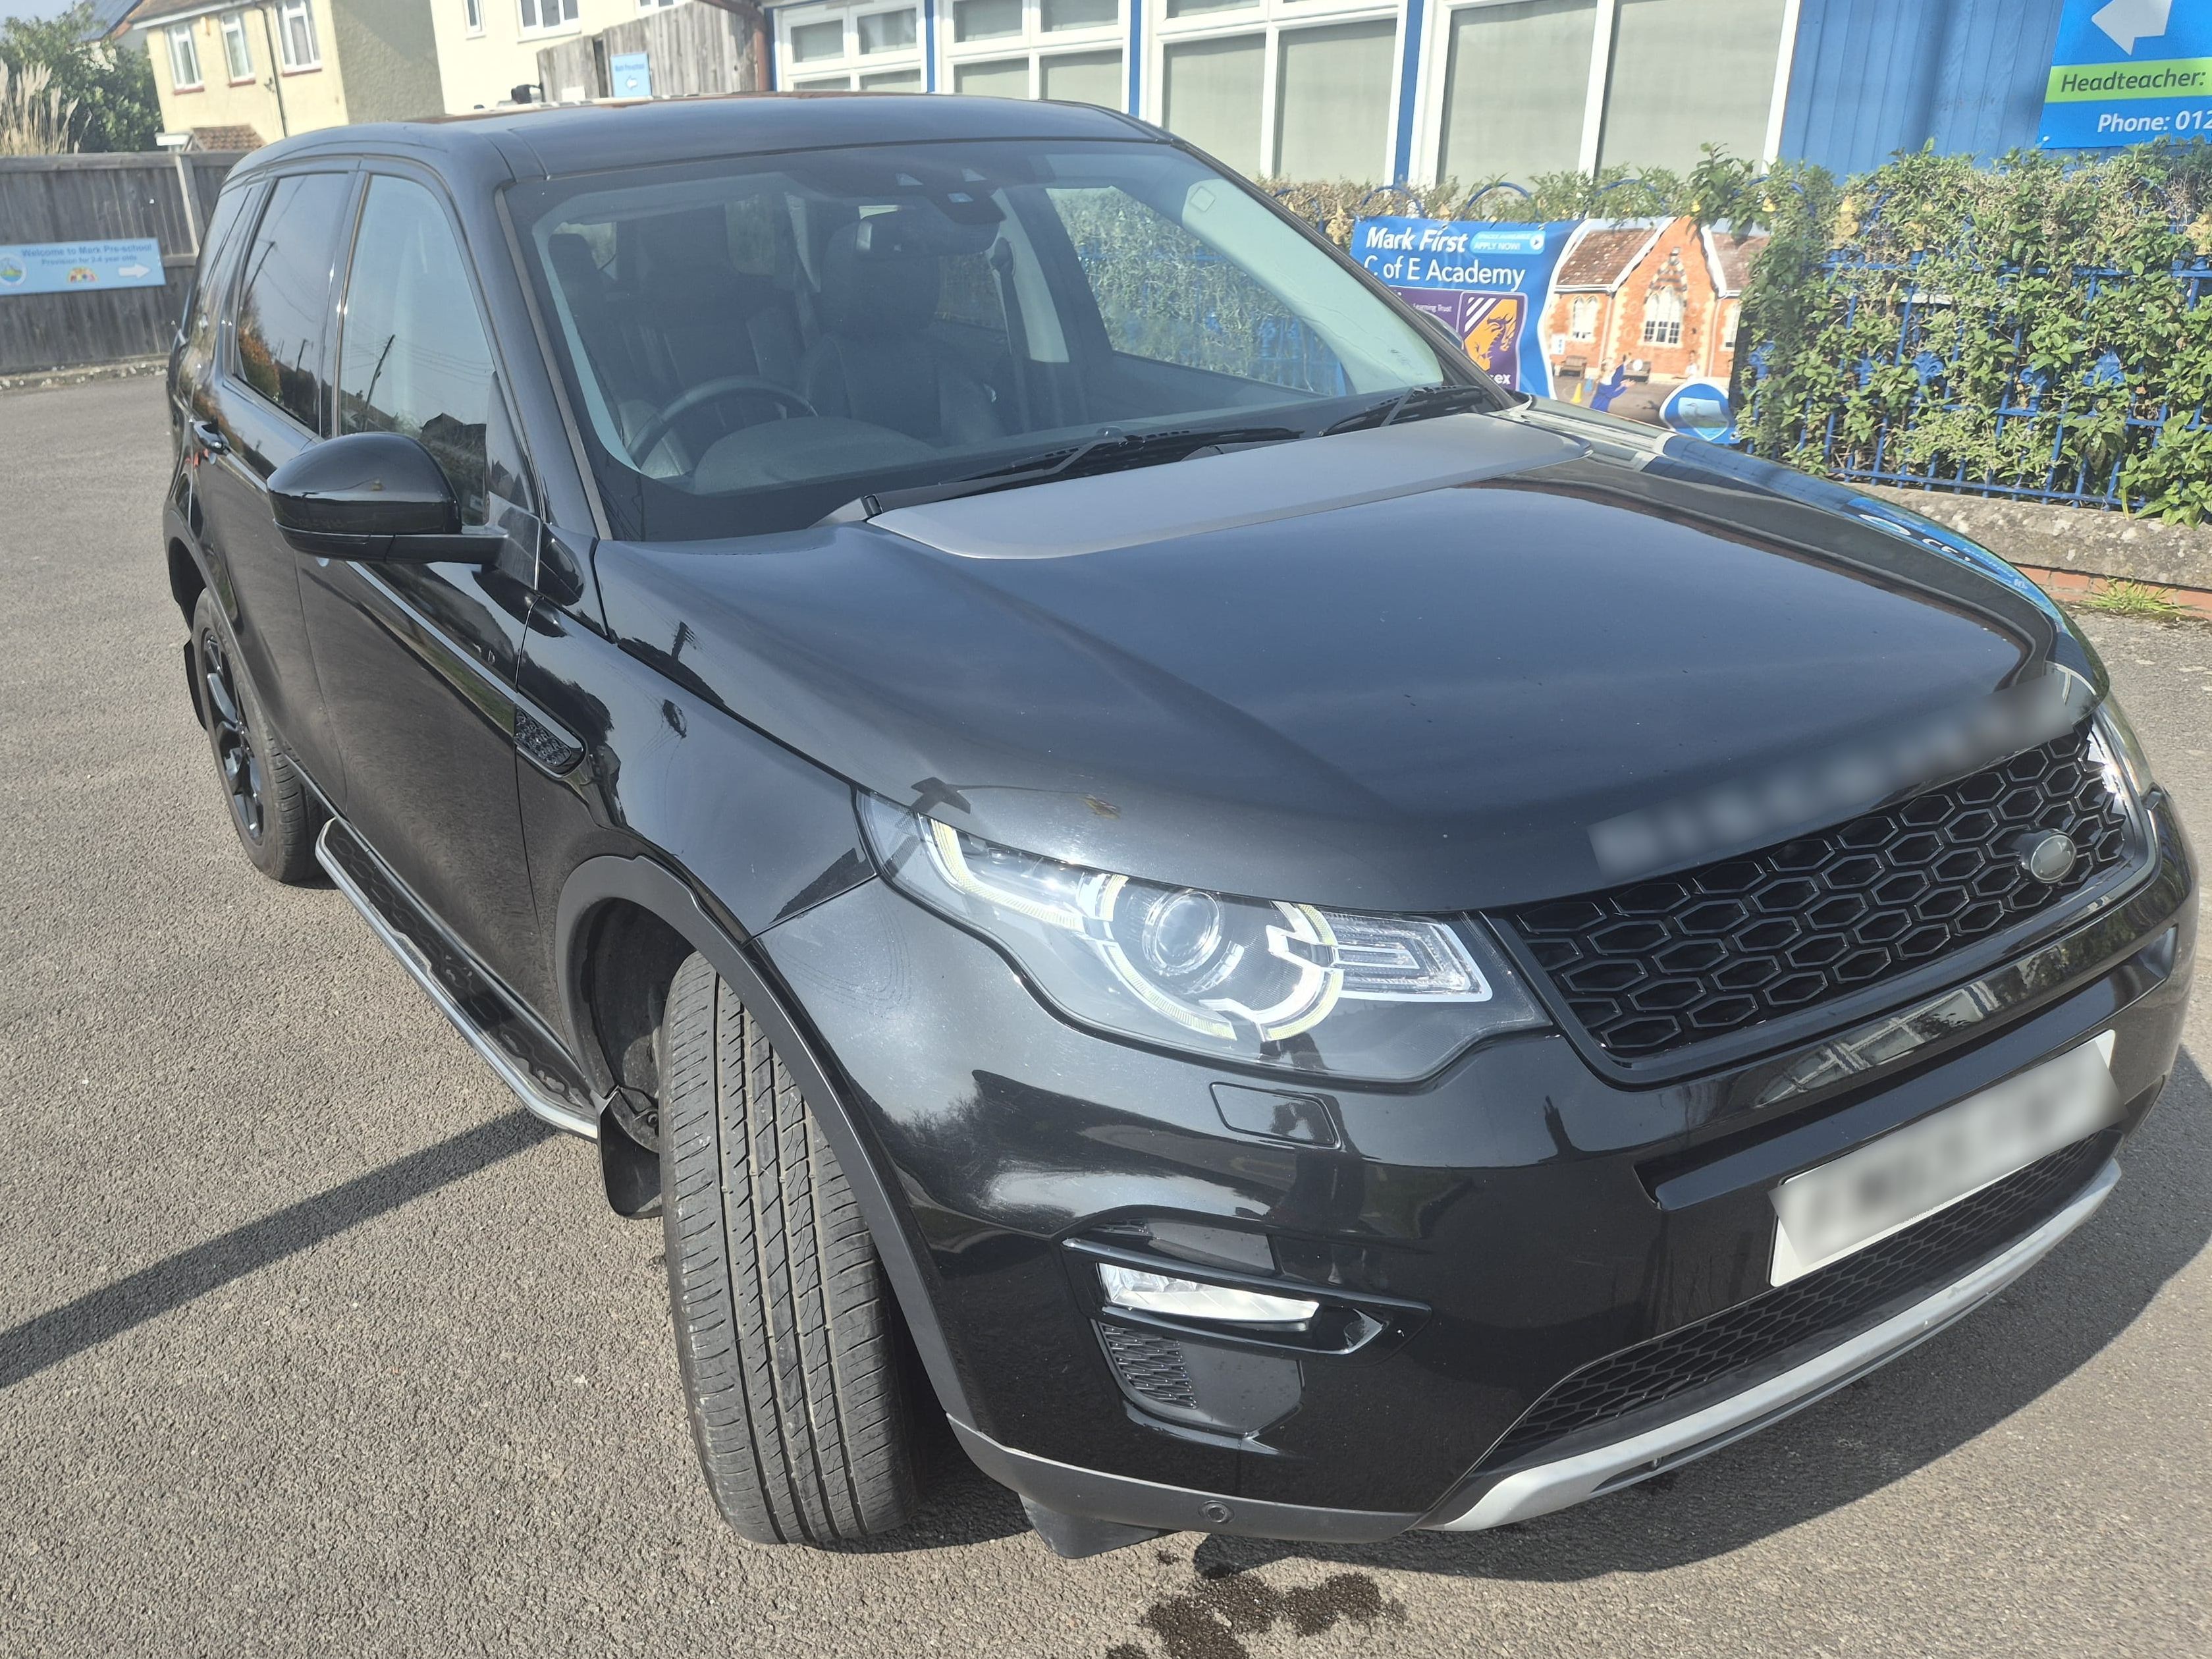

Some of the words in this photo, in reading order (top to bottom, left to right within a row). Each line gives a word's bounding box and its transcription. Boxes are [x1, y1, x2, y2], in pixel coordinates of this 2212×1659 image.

[2061, 68, 2206, 92] Headteacher:
[2097, 113, 2171, 132] Phone:
[21, 248, 65, 258] Welcome
[79, 246, 100, 254] Mark
[1366, 227, 1416, 250] Mark
[1419, 229, 1469, 253] First
[1383, 255, 1405, 279] of
[1407, 258, 1421, 281] E
[1425, 258, 1526, 292] Academy
